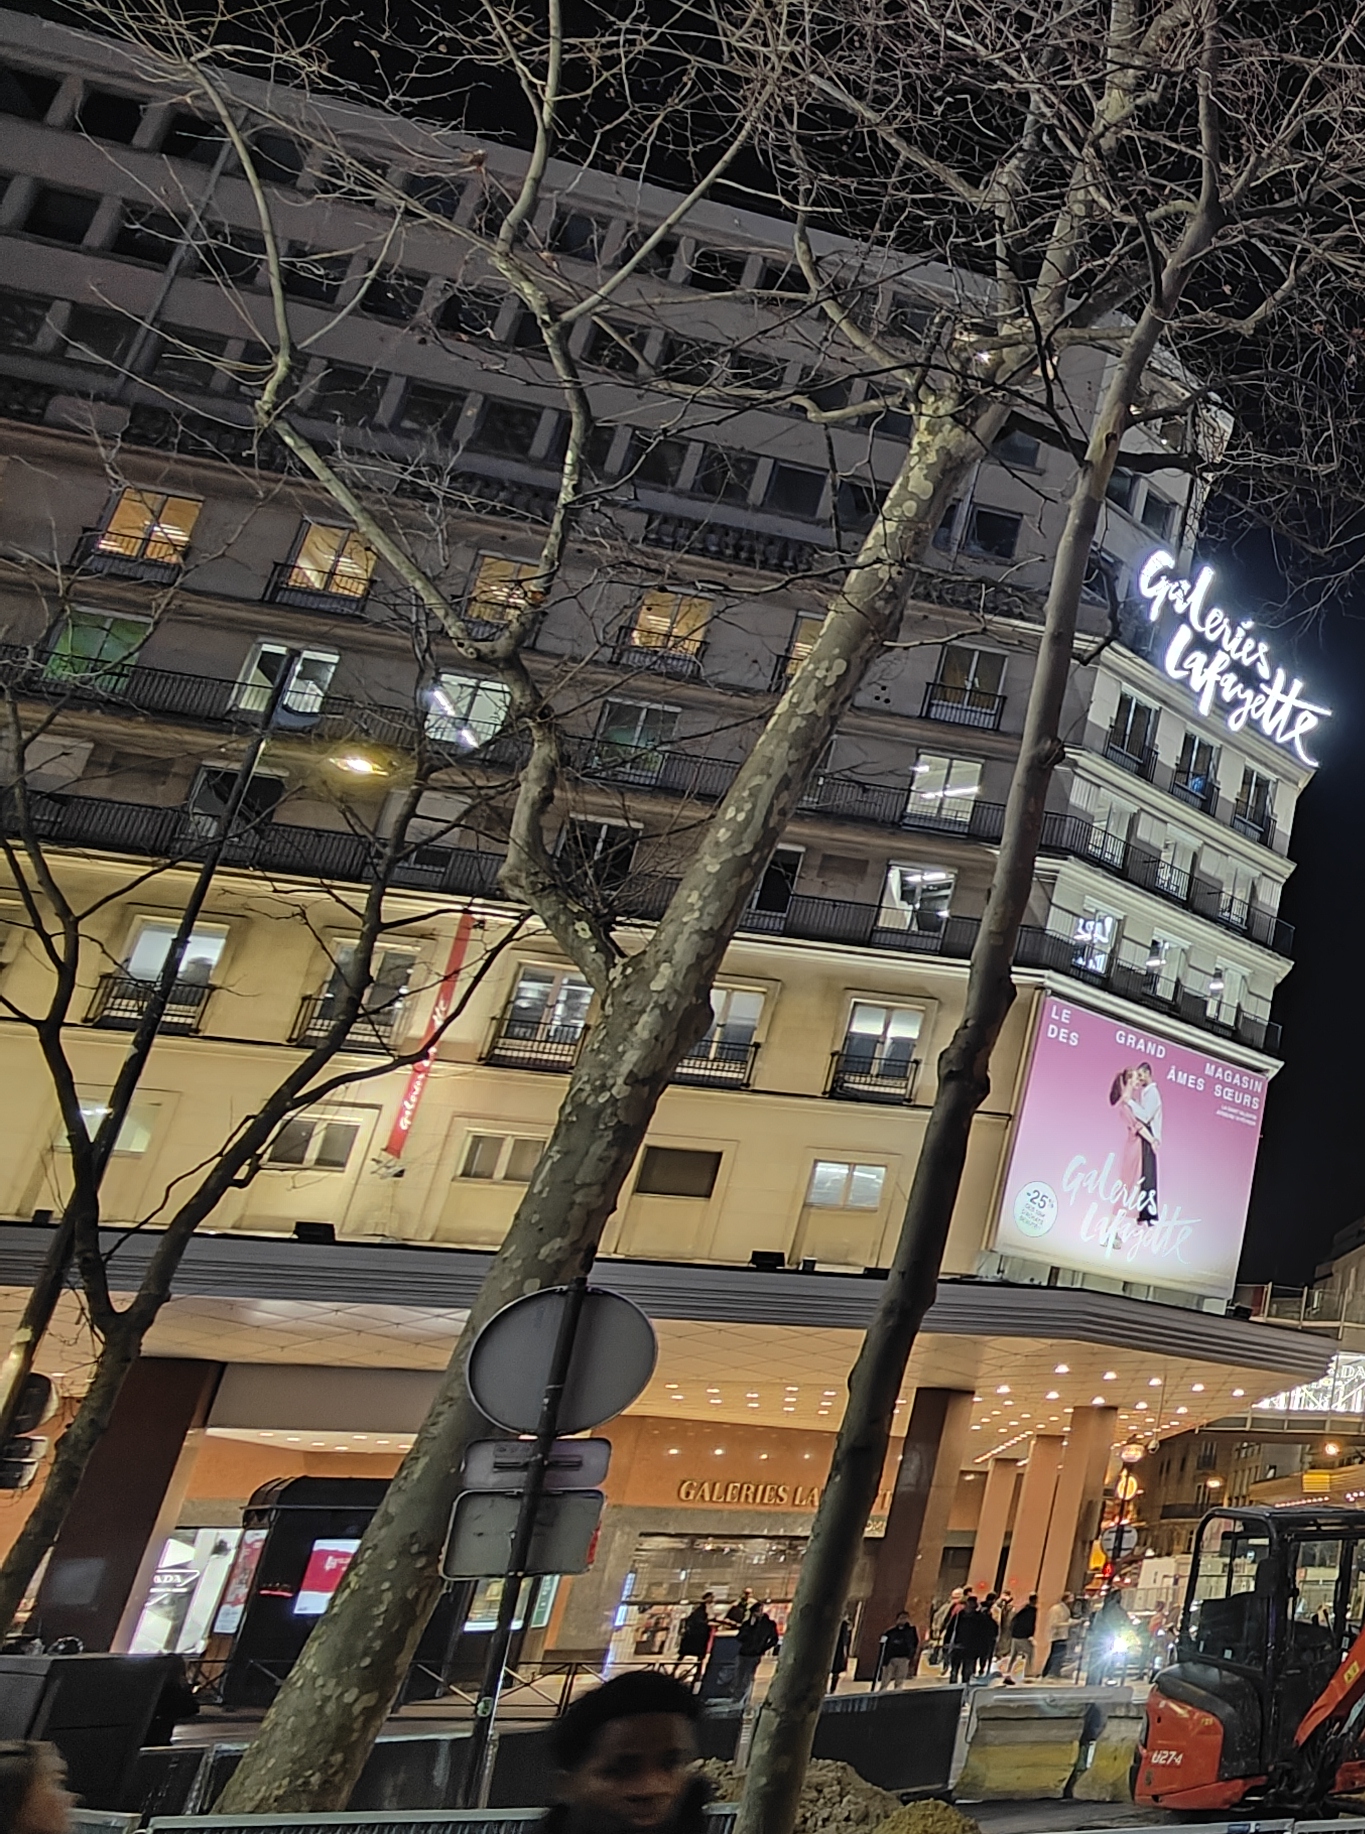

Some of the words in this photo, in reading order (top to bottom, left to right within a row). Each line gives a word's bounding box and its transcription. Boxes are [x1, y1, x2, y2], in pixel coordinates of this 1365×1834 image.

[1139, 550, 1270, 679] Galeries
[1165, 623, 1332, 767] Lafayette
[1047, 1023, 1080, 1047] DES
[1166, 1064, 1206, 1091] ÂMES
[1213, 1084, 1261, 1110] SŒURS
[1050, 1004, 1072, 1024] LE
[1115, 1029, 1167, 1060] GRAND
[1204, 1062, 1263, 1093] MAGASIN
[1061, 1152, 1158, 1216] Galeries
[1080, 1202, 1202, 1264] Lafayette
[680, 1480, 789, 1505] GALERIES
